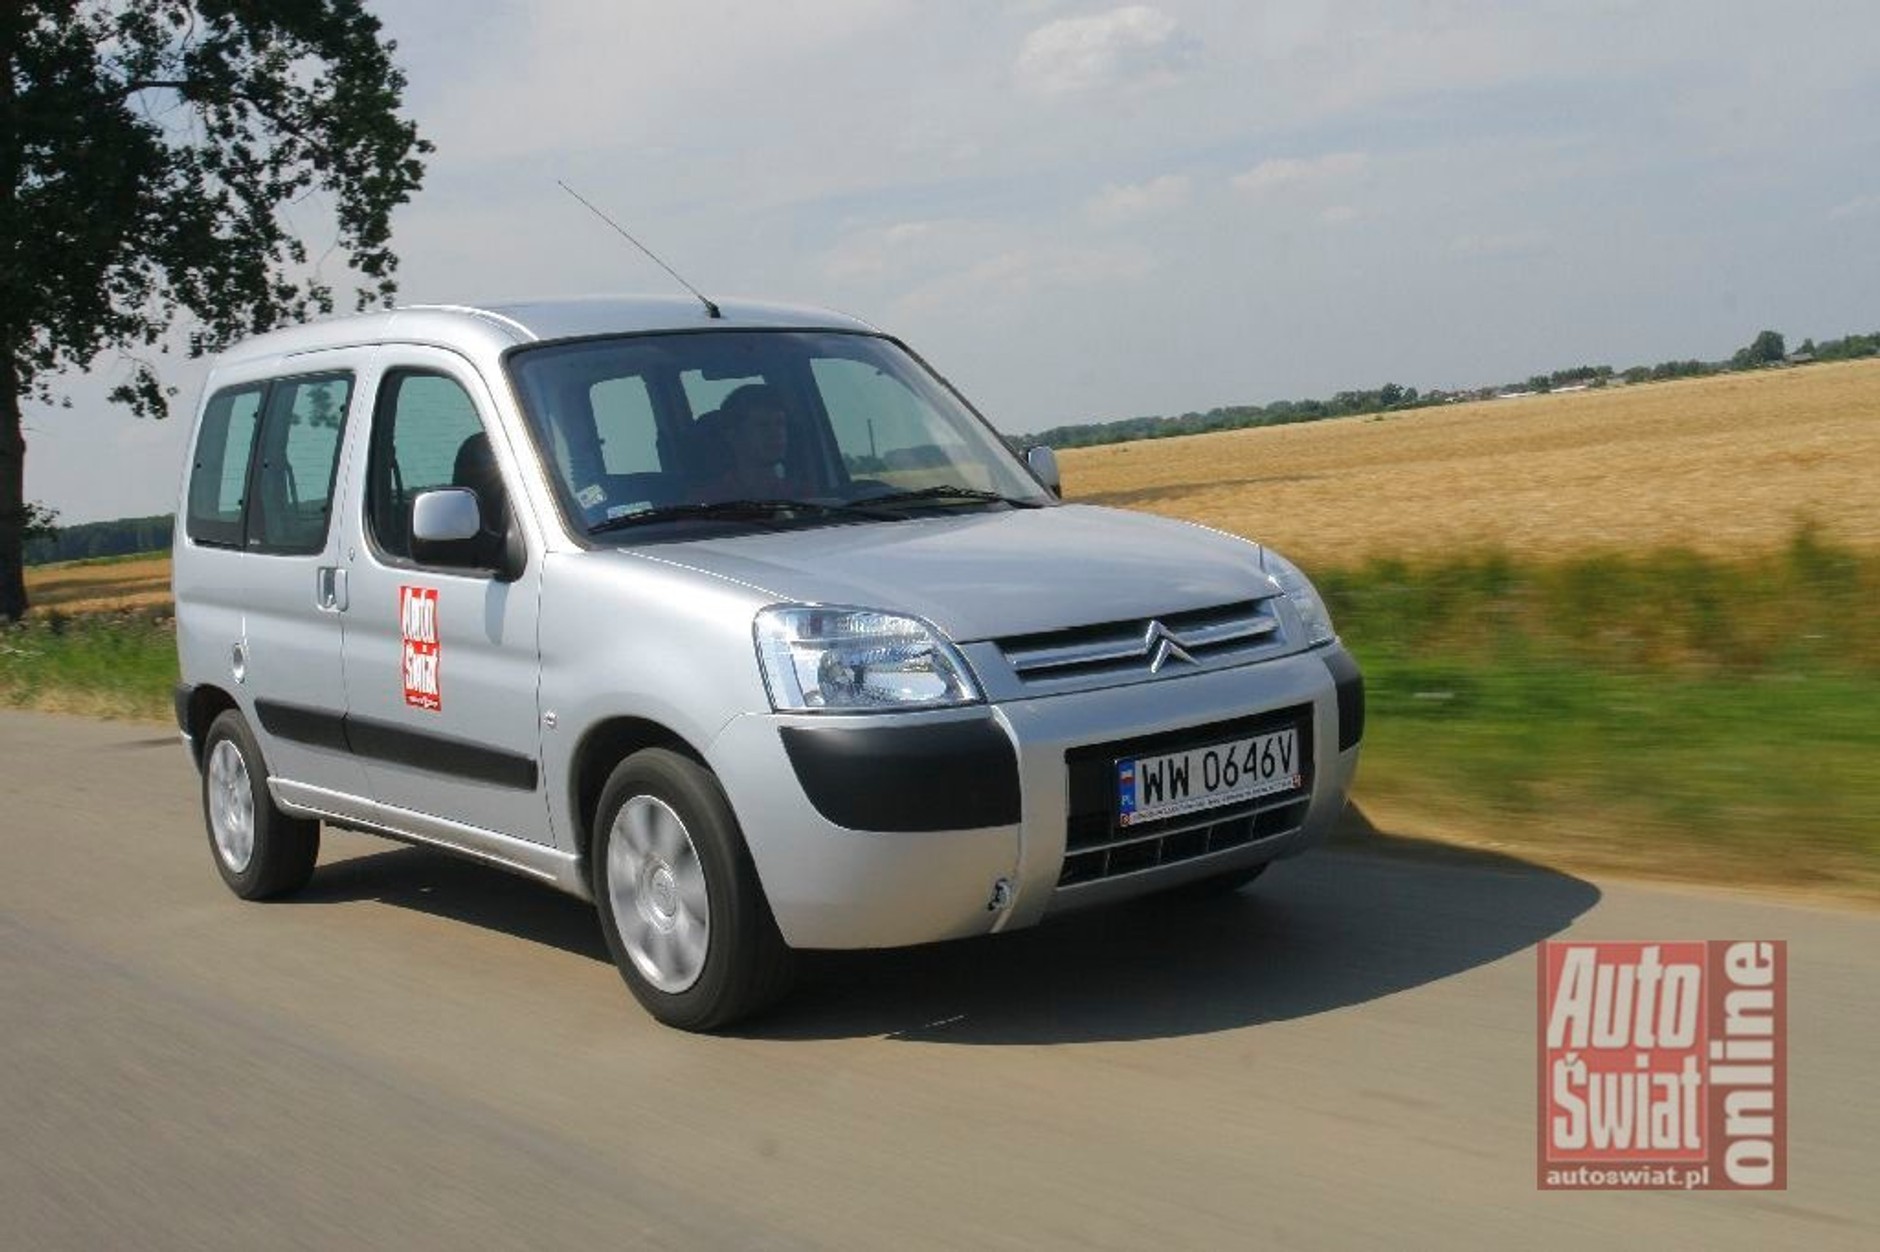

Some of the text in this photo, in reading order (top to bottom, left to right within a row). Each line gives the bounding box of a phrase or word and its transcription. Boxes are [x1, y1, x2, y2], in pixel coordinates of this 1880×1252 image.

[403, 587, 436, 643] Auto
[1142, 756, 1190, 805] WW
[1203, 732, 1293, 792] 0646V
